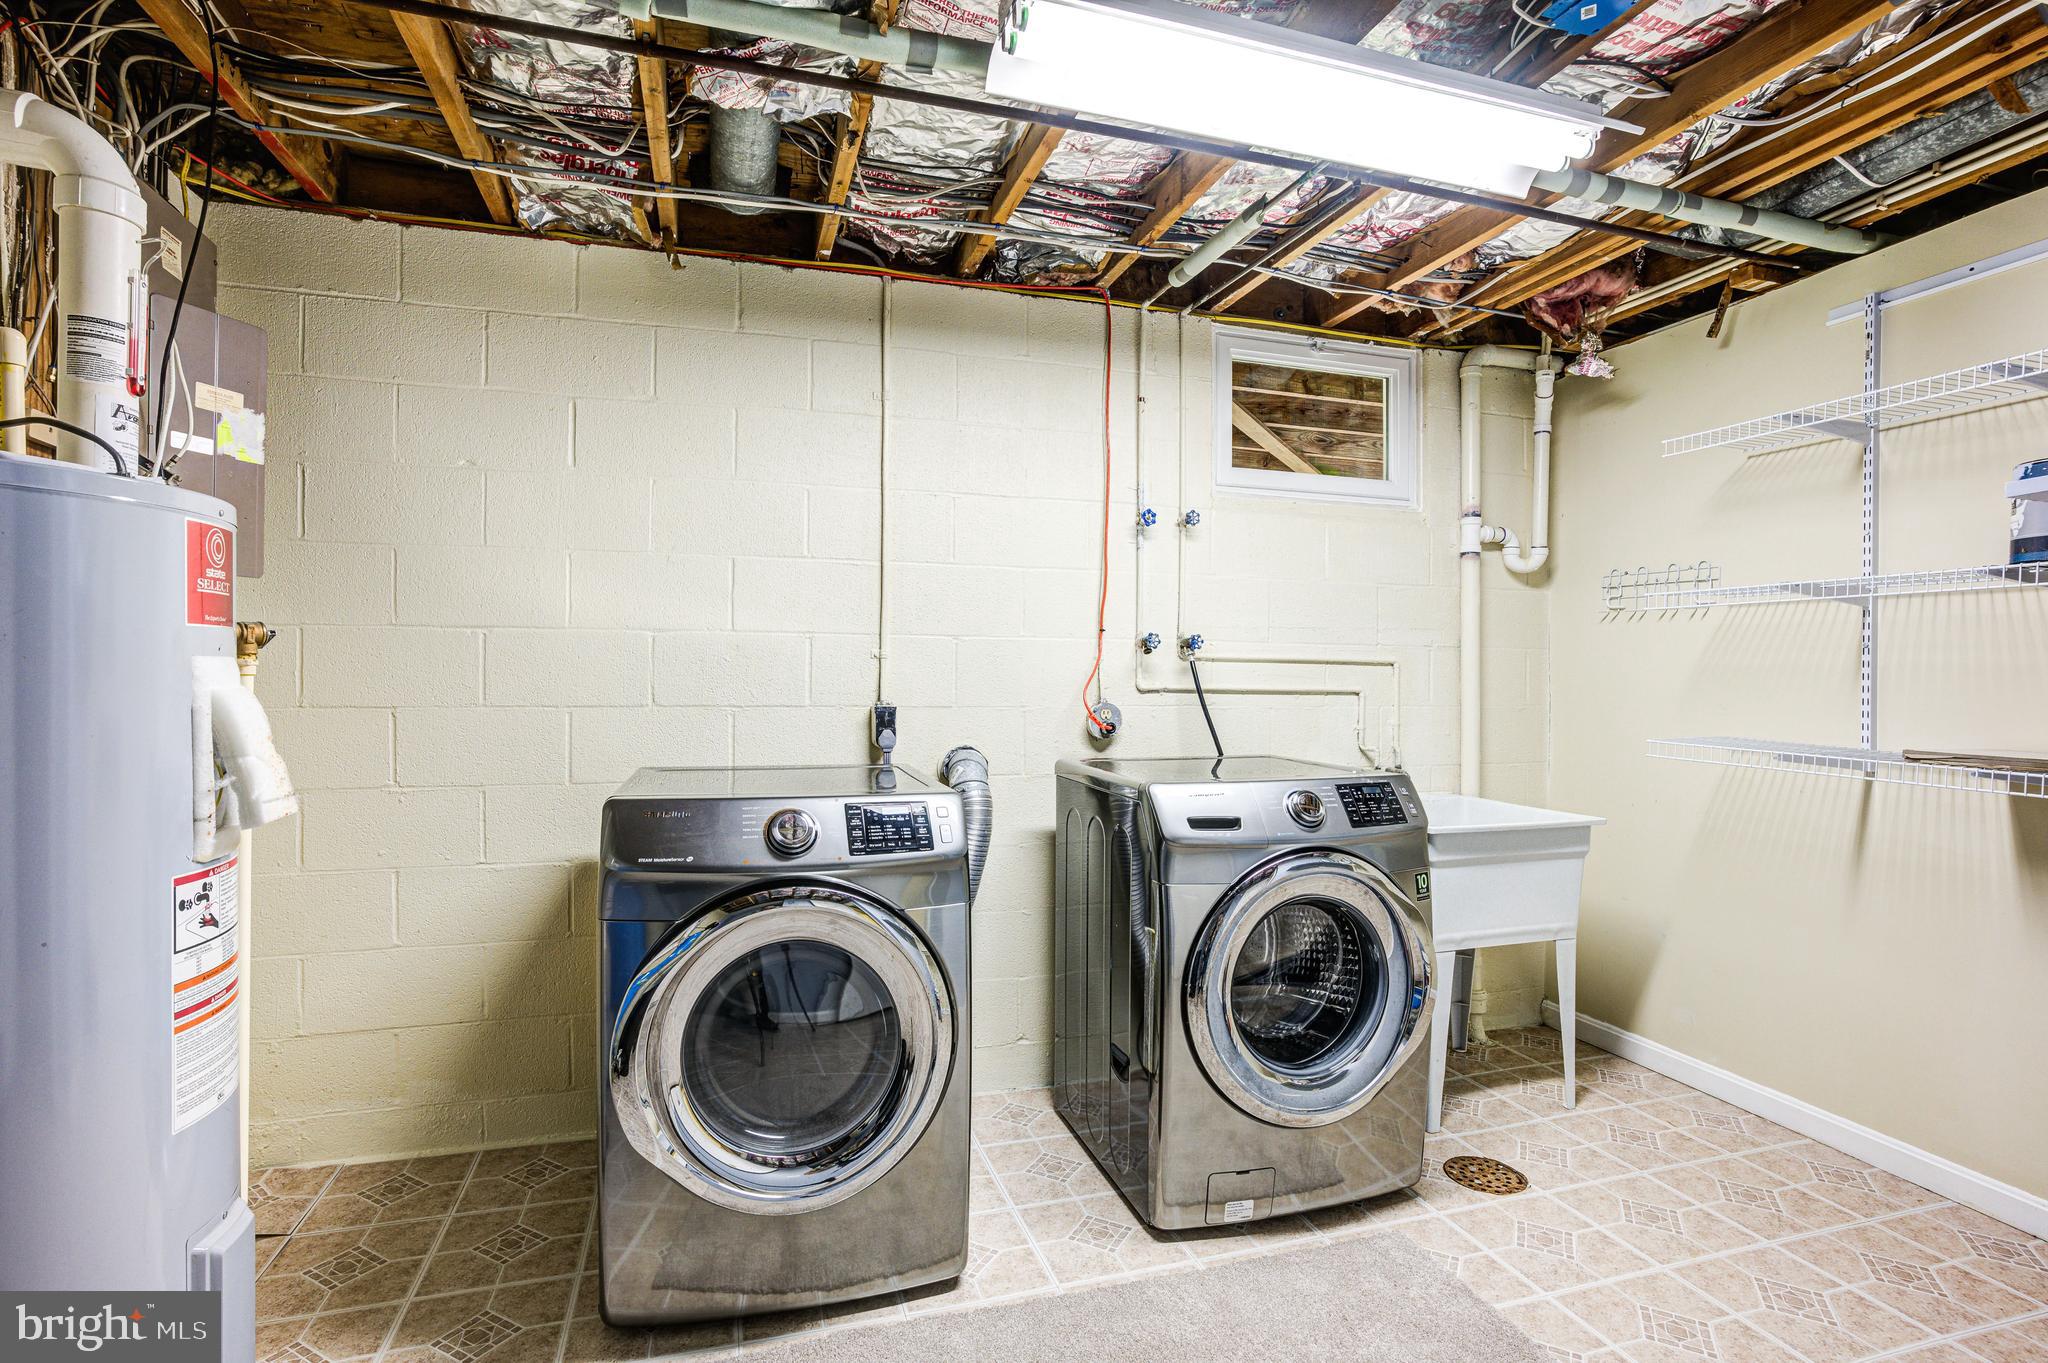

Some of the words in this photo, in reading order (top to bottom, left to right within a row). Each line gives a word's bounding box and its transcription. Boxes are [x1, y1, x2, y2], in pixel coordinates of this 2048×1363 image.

[917, 0, 986, 29] RFORMANCE
[961, 8, 999, 27] THERM
[197, 578, 230, 593] SELECT
[1416, 873, 1428, 889] 10
